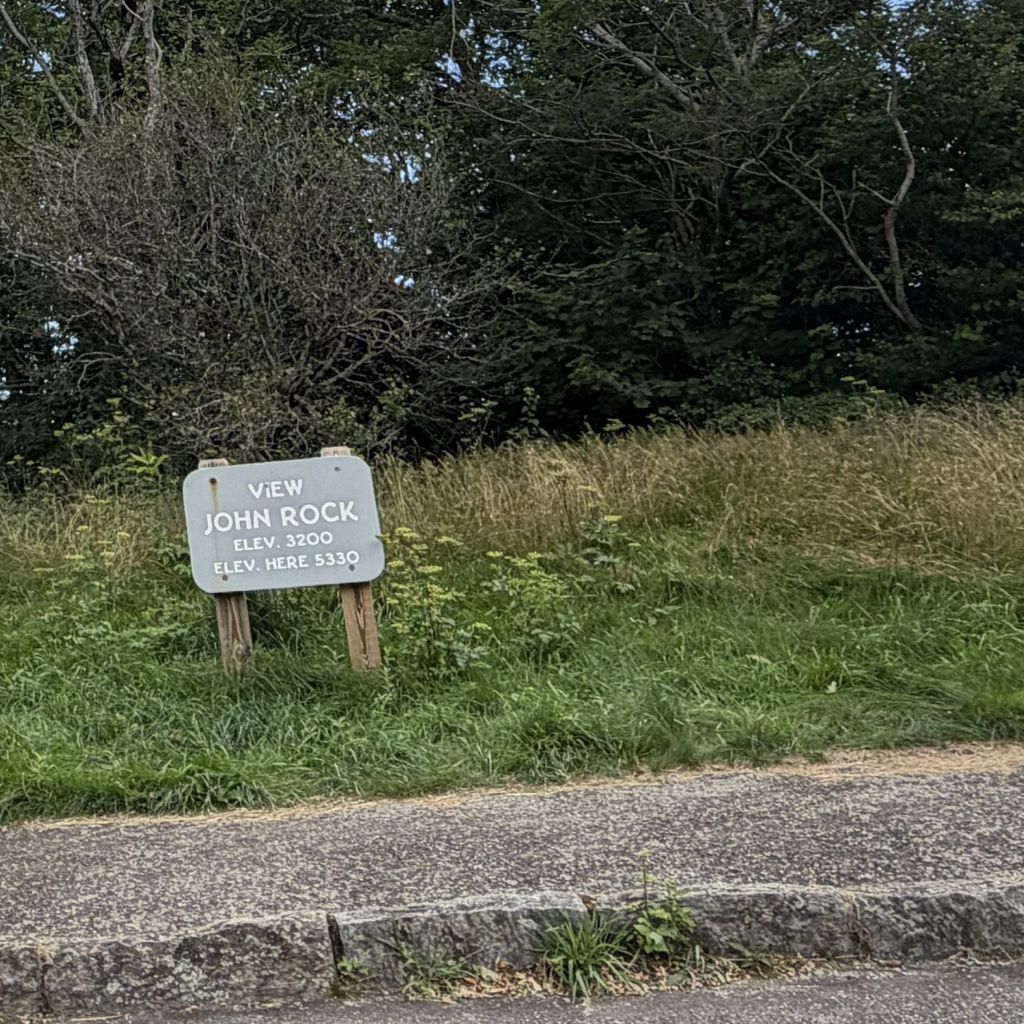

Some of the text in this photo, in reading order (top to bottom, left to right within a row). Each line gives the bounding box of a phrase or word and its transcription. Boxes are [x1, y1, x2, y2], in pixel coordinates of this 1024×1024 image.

[204, 501, 359, 536] JOHN ROCK
[233, 531, 333, 552] ELEV. 3200
[214, 550, 360, 575] ELEV. HERE 5330
